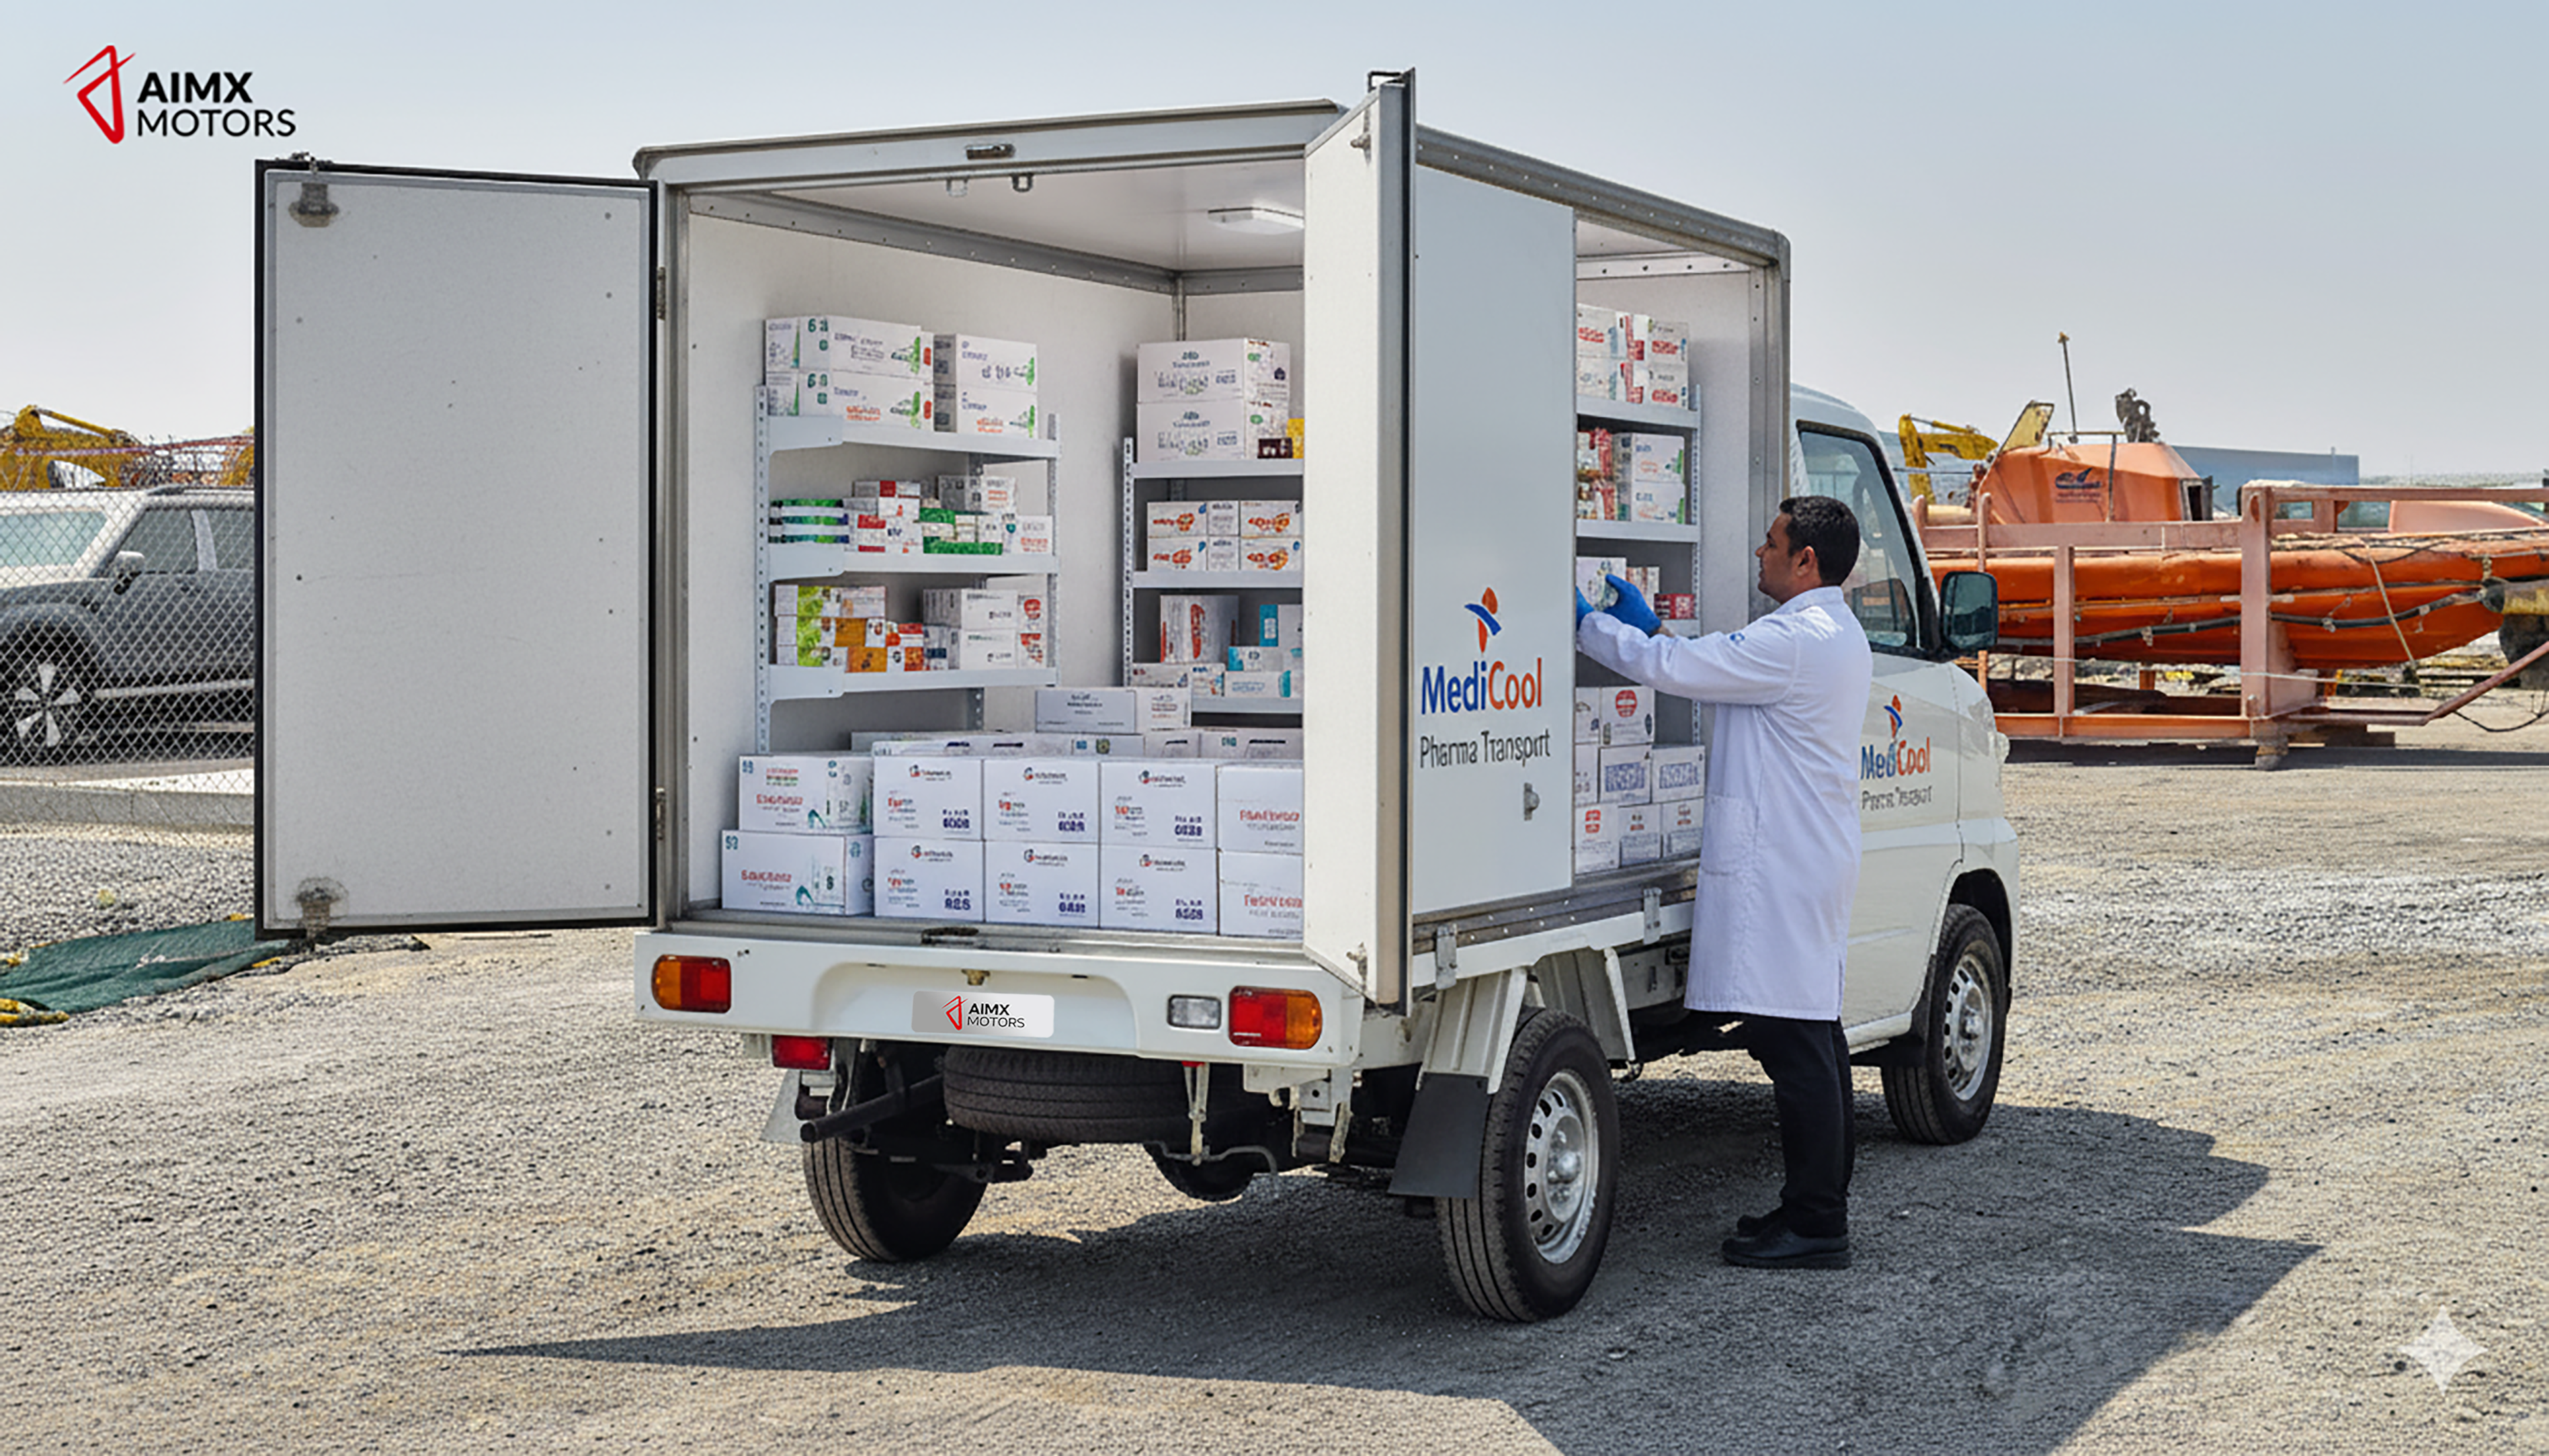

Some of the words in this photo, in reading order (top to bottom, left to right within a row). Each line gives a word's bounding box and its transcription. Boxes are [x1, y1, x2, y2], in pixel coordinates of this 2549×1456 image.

[1421, 656, 1542, 715] MediCool
[1420, 735, 1478, 769] Pharma
[1480, 728, 1551, 767] Transport
[967, 1016, 1026, 1028] MOTORS
[968, 1002, 1010, 1016] AIMX
